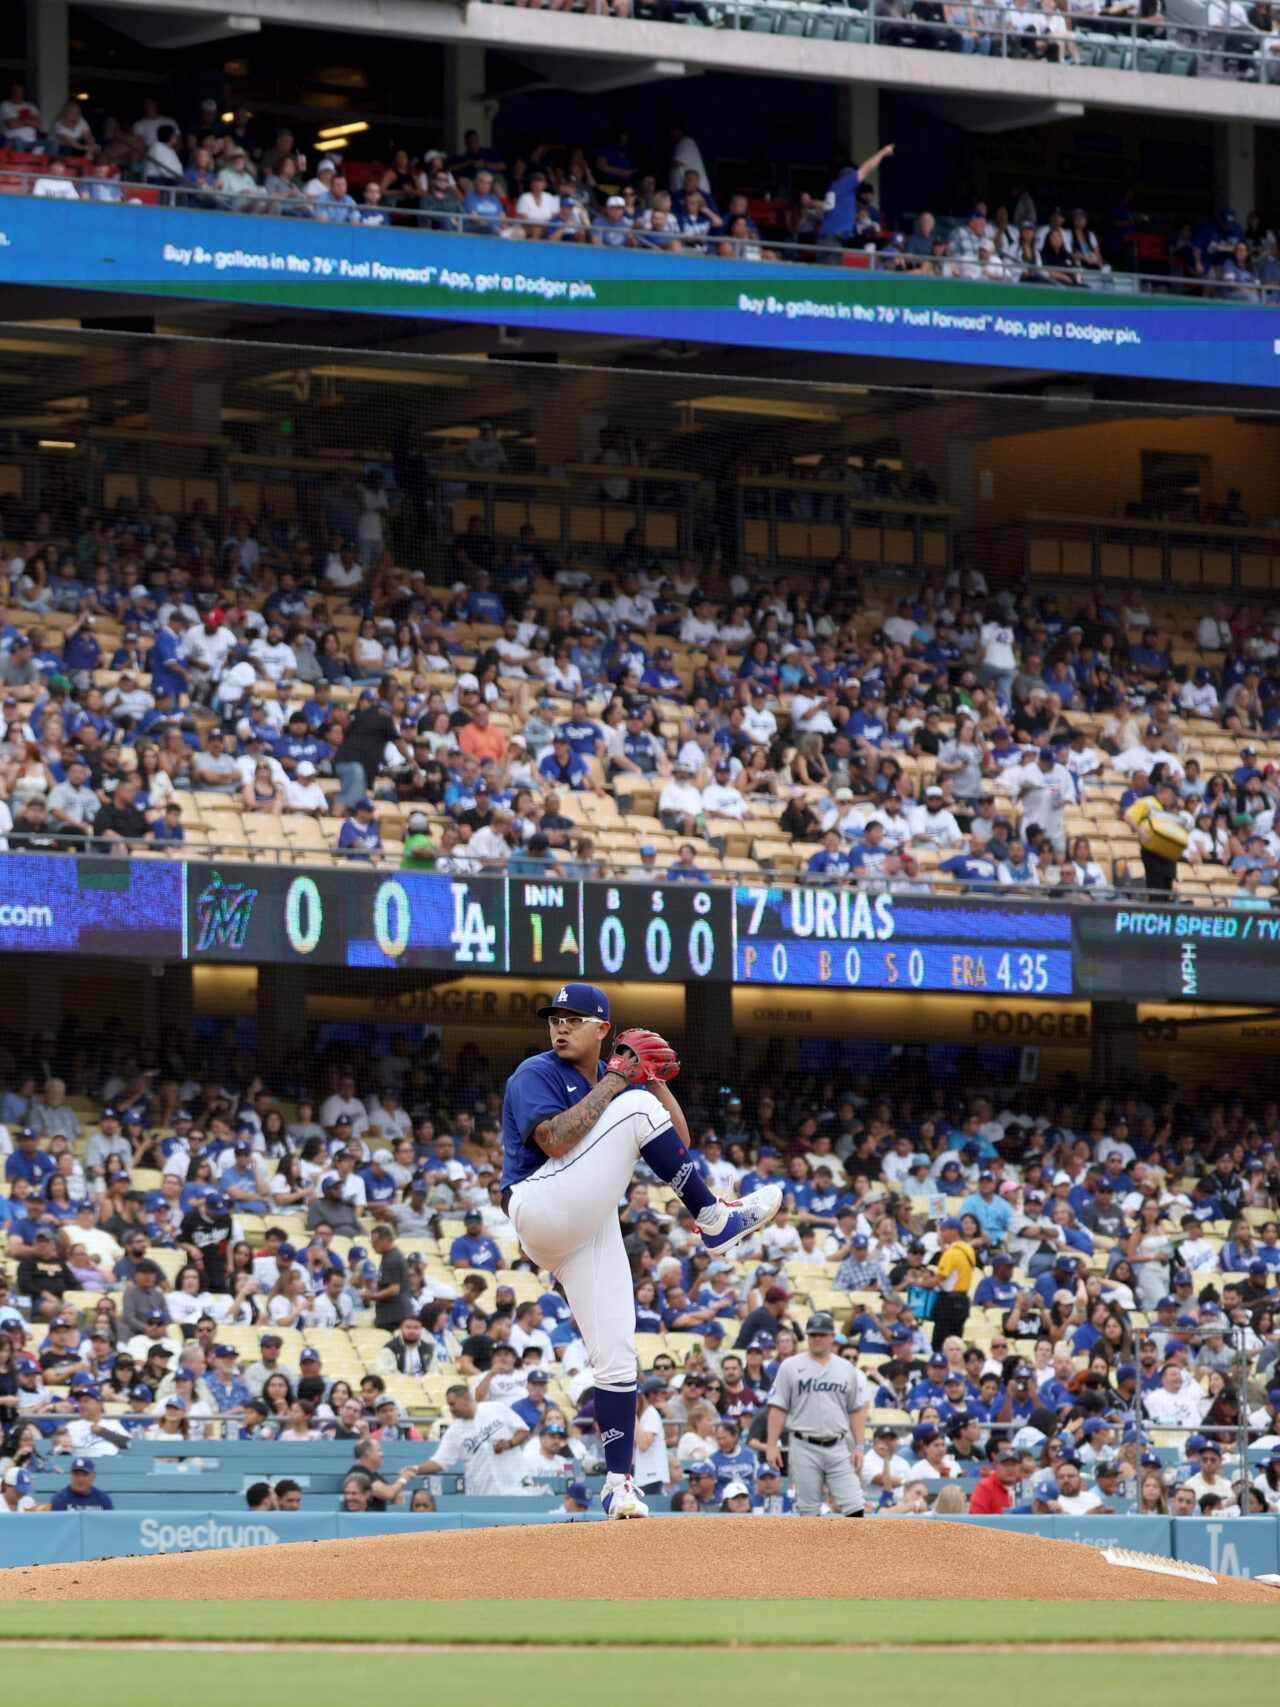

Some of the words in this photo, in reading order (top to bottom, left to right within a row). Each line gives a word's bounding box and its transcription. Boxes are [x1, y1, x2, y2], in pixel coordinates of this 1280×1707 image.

[163, 244, 192, 265] Buy
[214, 250, 269, 270] gallons
[271, 253, 285, 269] in
[287, 255, 310, 273] the
[340, 259, 370, 278] Fuel
[475, 273, 500, 291] get
[501, 276, 513, 290] a
[515, 274, 568, 298] Dodger
[739, 294, 765, 315] Buy
[786, 301, 836, 318] gallons
[837, 305, 851, 318] in
[853, 305, 875, 321] the
[902, 308, 930, 326] Fuel
[1028, 321, 1051, 339] get
[1053, 324, 1064, 338] a
[1065, 322, 1114, 344] Dodger
[285, 875, 323, 954] 0
[373, 880, 411, 957] 0
[524, 884, 565, 908] INN
[606, 887, 621, 910] B
[651, 890, 665, 914] S
[693, 891, 712, 915] O
[747, 888, 769, 935] 7
[790, 887, 897, 941] URIAS
[530, 912, 544, 963] 1
[598, 915, 626, 975] 0
[645, 916, 672, 976] 0
[687, 918, 715, 977] 0
[1114, 911, 1172, 936] PITCH
[1174, 913, 1239, 939] SPEED
[743, 945, 757, 979] P
[771, 942, 789, 980] 0
[818, 949, 833, 982] B
[844, 946, 862, 985] 0
[884, 952, 899, 984] S
[907, 948, 925, 988] 0
[951, 952, 988, 988] ERA
[996, 951, 1049, 993] 4.35
[1180, 942, 1198, 995] MPH
[972, 1010, 1090, 1039] DODGER
[798, 1376, 849, 1396] Miami
[140, 1518, 271, 1551] Spectrum
